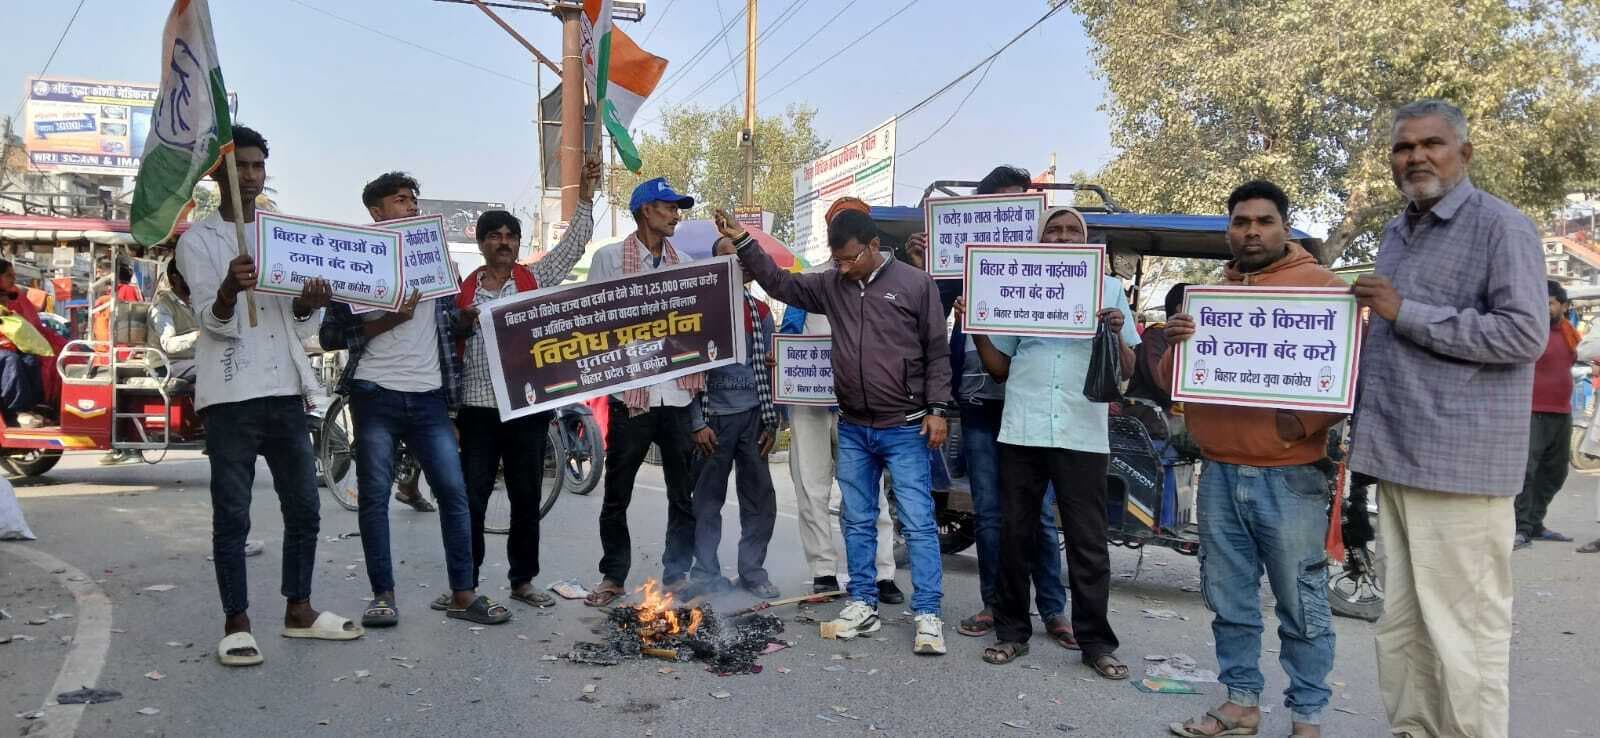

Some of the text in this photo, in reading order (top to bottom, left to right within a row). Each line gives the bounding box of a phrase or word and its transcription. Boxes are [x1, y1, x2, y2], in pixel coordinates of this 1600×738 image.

[117, 157, 140, 166] IMA
[943, 209, 961, 226] करोड़
[963, 212, 973, 224] 80
[974, 211, 992, 223] लाख
[993, 206, 1023, 223] नौकरियों
[1025, 209, 1035, 222] का
[273, 227, 388, 257] बिहार के युवाओं को
[939, 225, 1033, 249] क्या हुआ जवाब दो हिसाब दो
[289, 251, 373, 275] ठगना बंद करो
[980, 258, 1088, 279] बिहार के साथ नाइंसाफी
[332, 279, 346, 291] युवा
[347, 280, 371, 294] कांग्रेस
[505, 271, 719, 326] बिहार को विशेष राज्य का दर्जा न देने और 1,25,000 लाख करोड़
[1000, 283, 1065, 300] करना बंद करो
[532, 326, 543, 339] का
[544, 317, 574, 336] अतिरिक्त
[594, 309, 608, 324] देने
[608, 307, 619, 321] का
[619, 304, 640, 319] वायदा
[641, 299, 660, 315] तोड़ने
[660, 297, 669, 312] के
[669, 294, 698, 310] खिलाफ
[993, 307, 1069, 322] बिहार प्रदेश युवा कांग्रेस
[1200, 307, 1337, 331] बिहार के किसानों
[530, 311, 703, 369] विरोध प्रदर्शन
[1196, 335, 1336, 361] को ठगना बंद करो
[576, 338, 665, 374] पुतला दहन
[787, 346, 808, 361] बिहार
[809, 346, 818, 360] के
[580, 357, 668, 386] बिहार प्रदेश युवा कांग्रेस
[784, 364, 834, 378] नाइंसाफी कर
[1214, 368, 1312, 388] बिहार प्रदेश युवा कांग्रेस
